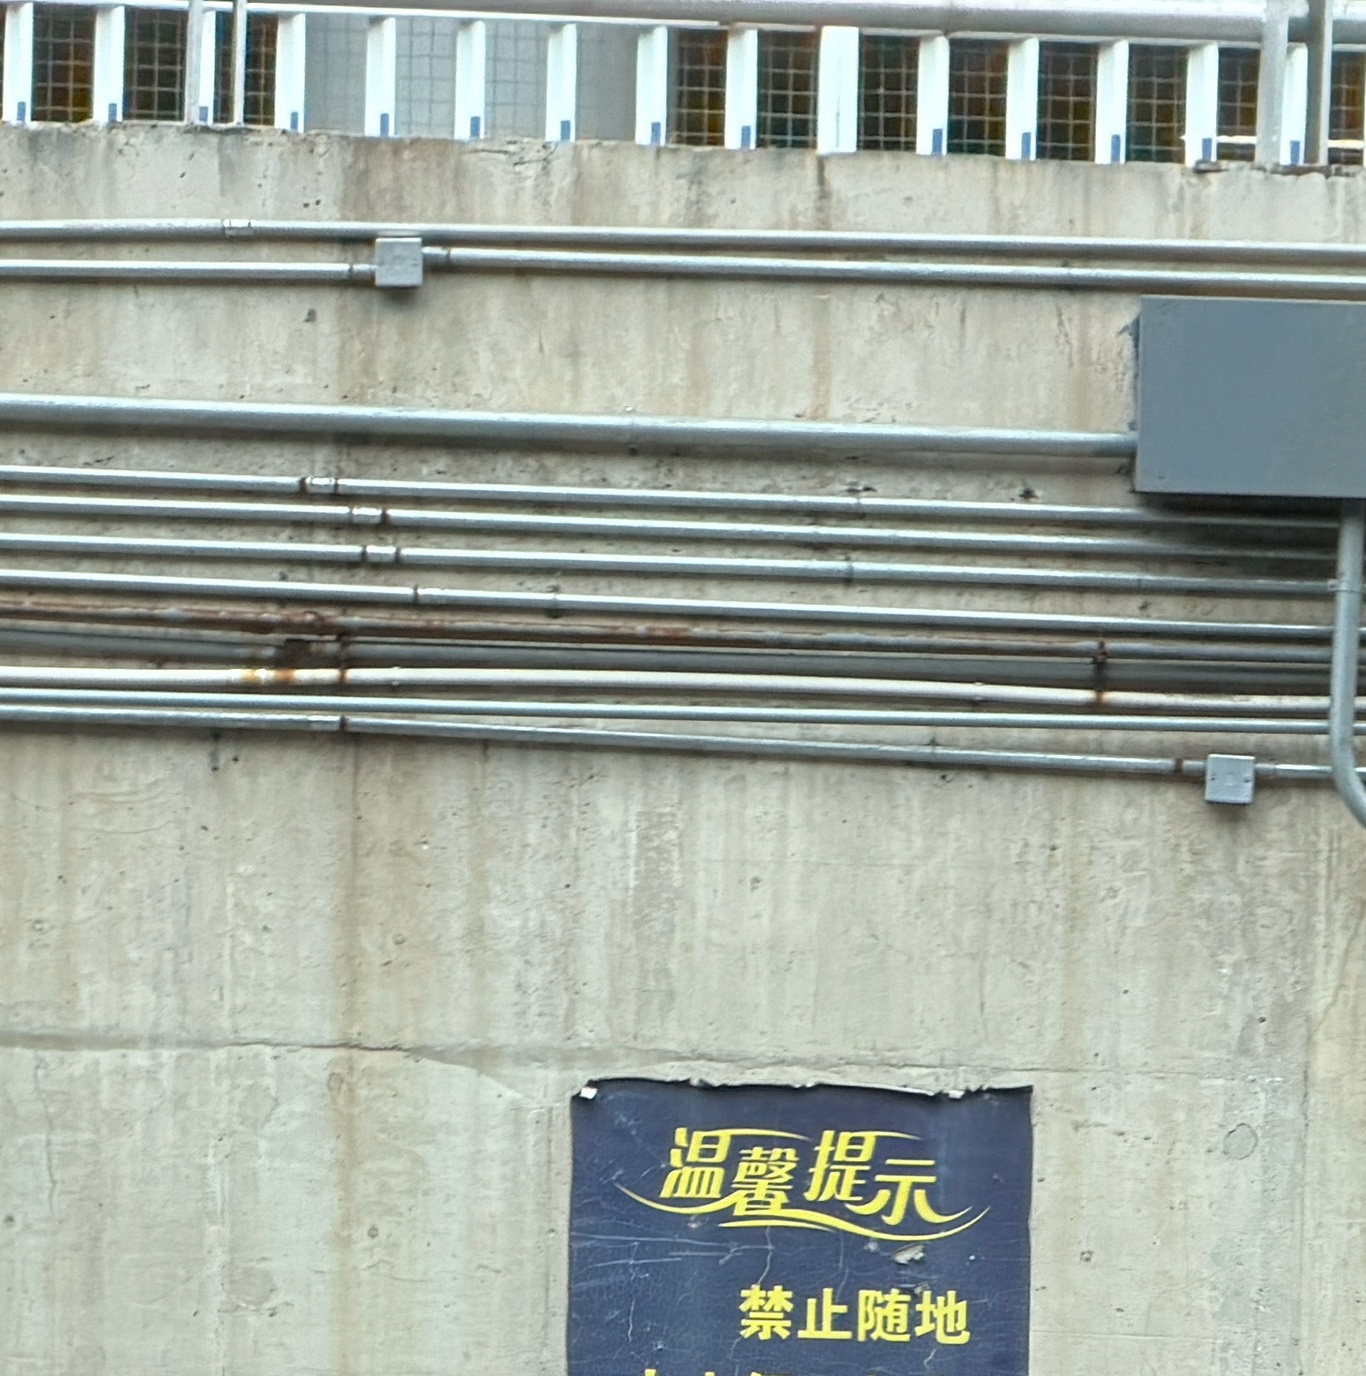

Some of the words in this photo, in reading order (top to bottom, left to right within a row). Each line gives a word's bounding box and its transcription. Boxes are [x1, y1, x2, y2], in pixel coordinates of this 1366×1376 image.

[657, 1126, 975, 1228] 温馨提示
[739, 1285, 971, 1345] 禁止随地
